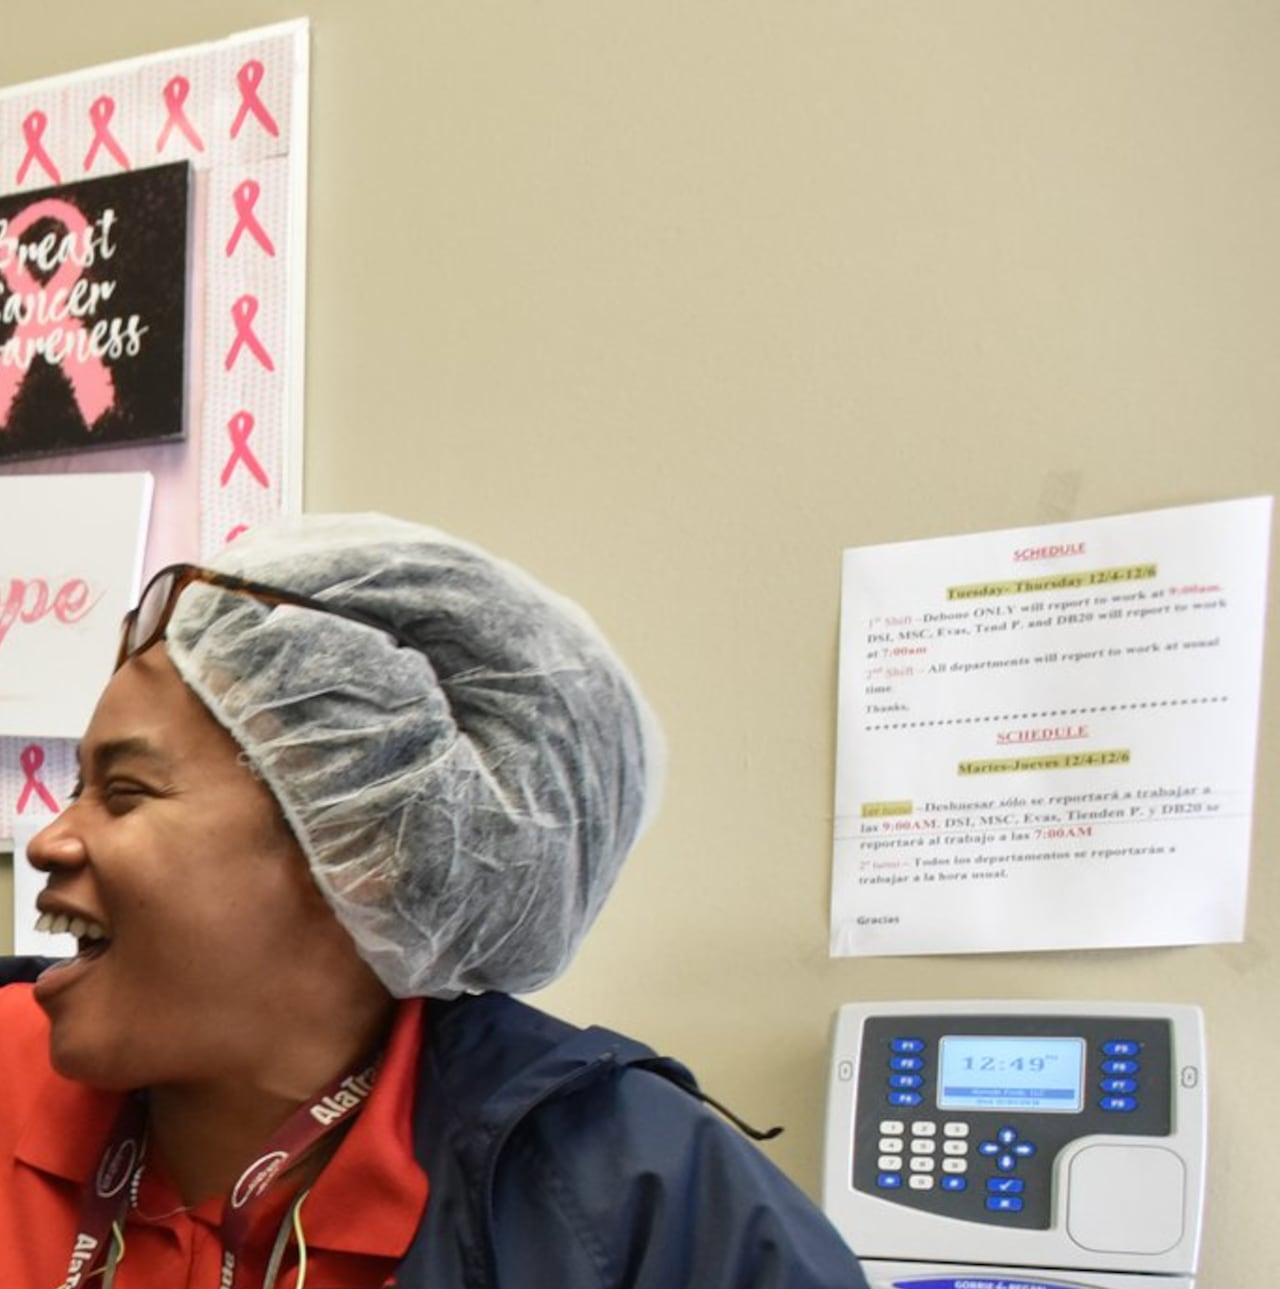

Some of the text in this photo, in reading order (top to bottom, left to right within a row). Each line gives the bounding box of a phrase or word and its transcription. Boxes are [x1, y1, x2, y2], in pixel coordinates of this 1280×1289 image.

[1013, 542, 1086, 562] SCHEDULE
[1017, 574, 1083, 592] Thursday
[973, 605, 1018, 618] ONLY
[1020, 602, 1046, 613] will
[1048, 597, 1095, 612] report
[1112, 591, 1146, 604] work
[976, 618, 1007, 634] Tend
[1028, 615, 1052, 628] and
[1098, 609, 1123, 621] will
[1127, 604, 1171, 619] report
[1192, 599, 1228, 611] work
[950, 656, 1030, 674] departments
[1034, 652, 1058, 664] will
[1061, 649, 1105, 663] report
[1126, 642, 1160, 655] work
[1182, 637, 1221, 649] usual
[865, 684, 893, 695] time
[996, 726, 1089, 744] SCHEDULE
[958, 751, 1130, 775] Martes-Jueves 12/4-12/6
[1137, 785, 1198, 800] trabajar
[860, 823, 878, 833] las
[1067, 806, 1125, 821] Tienden
[945, 831, 995, 846] trabajo
[1012, 830, 1030, 841] las
[1035, 827, 1092, 841] 7:00AM
[975, 850, 1071, 865] departamentos
[859, 873, 909, 886] trabajar
[939, 870, 968, 881] hora
[857, 915, 900, 926] Gracias
[961, 1055, 1045, 1073] 12:49
[310, 1067, 375, 1126] AlaTr
